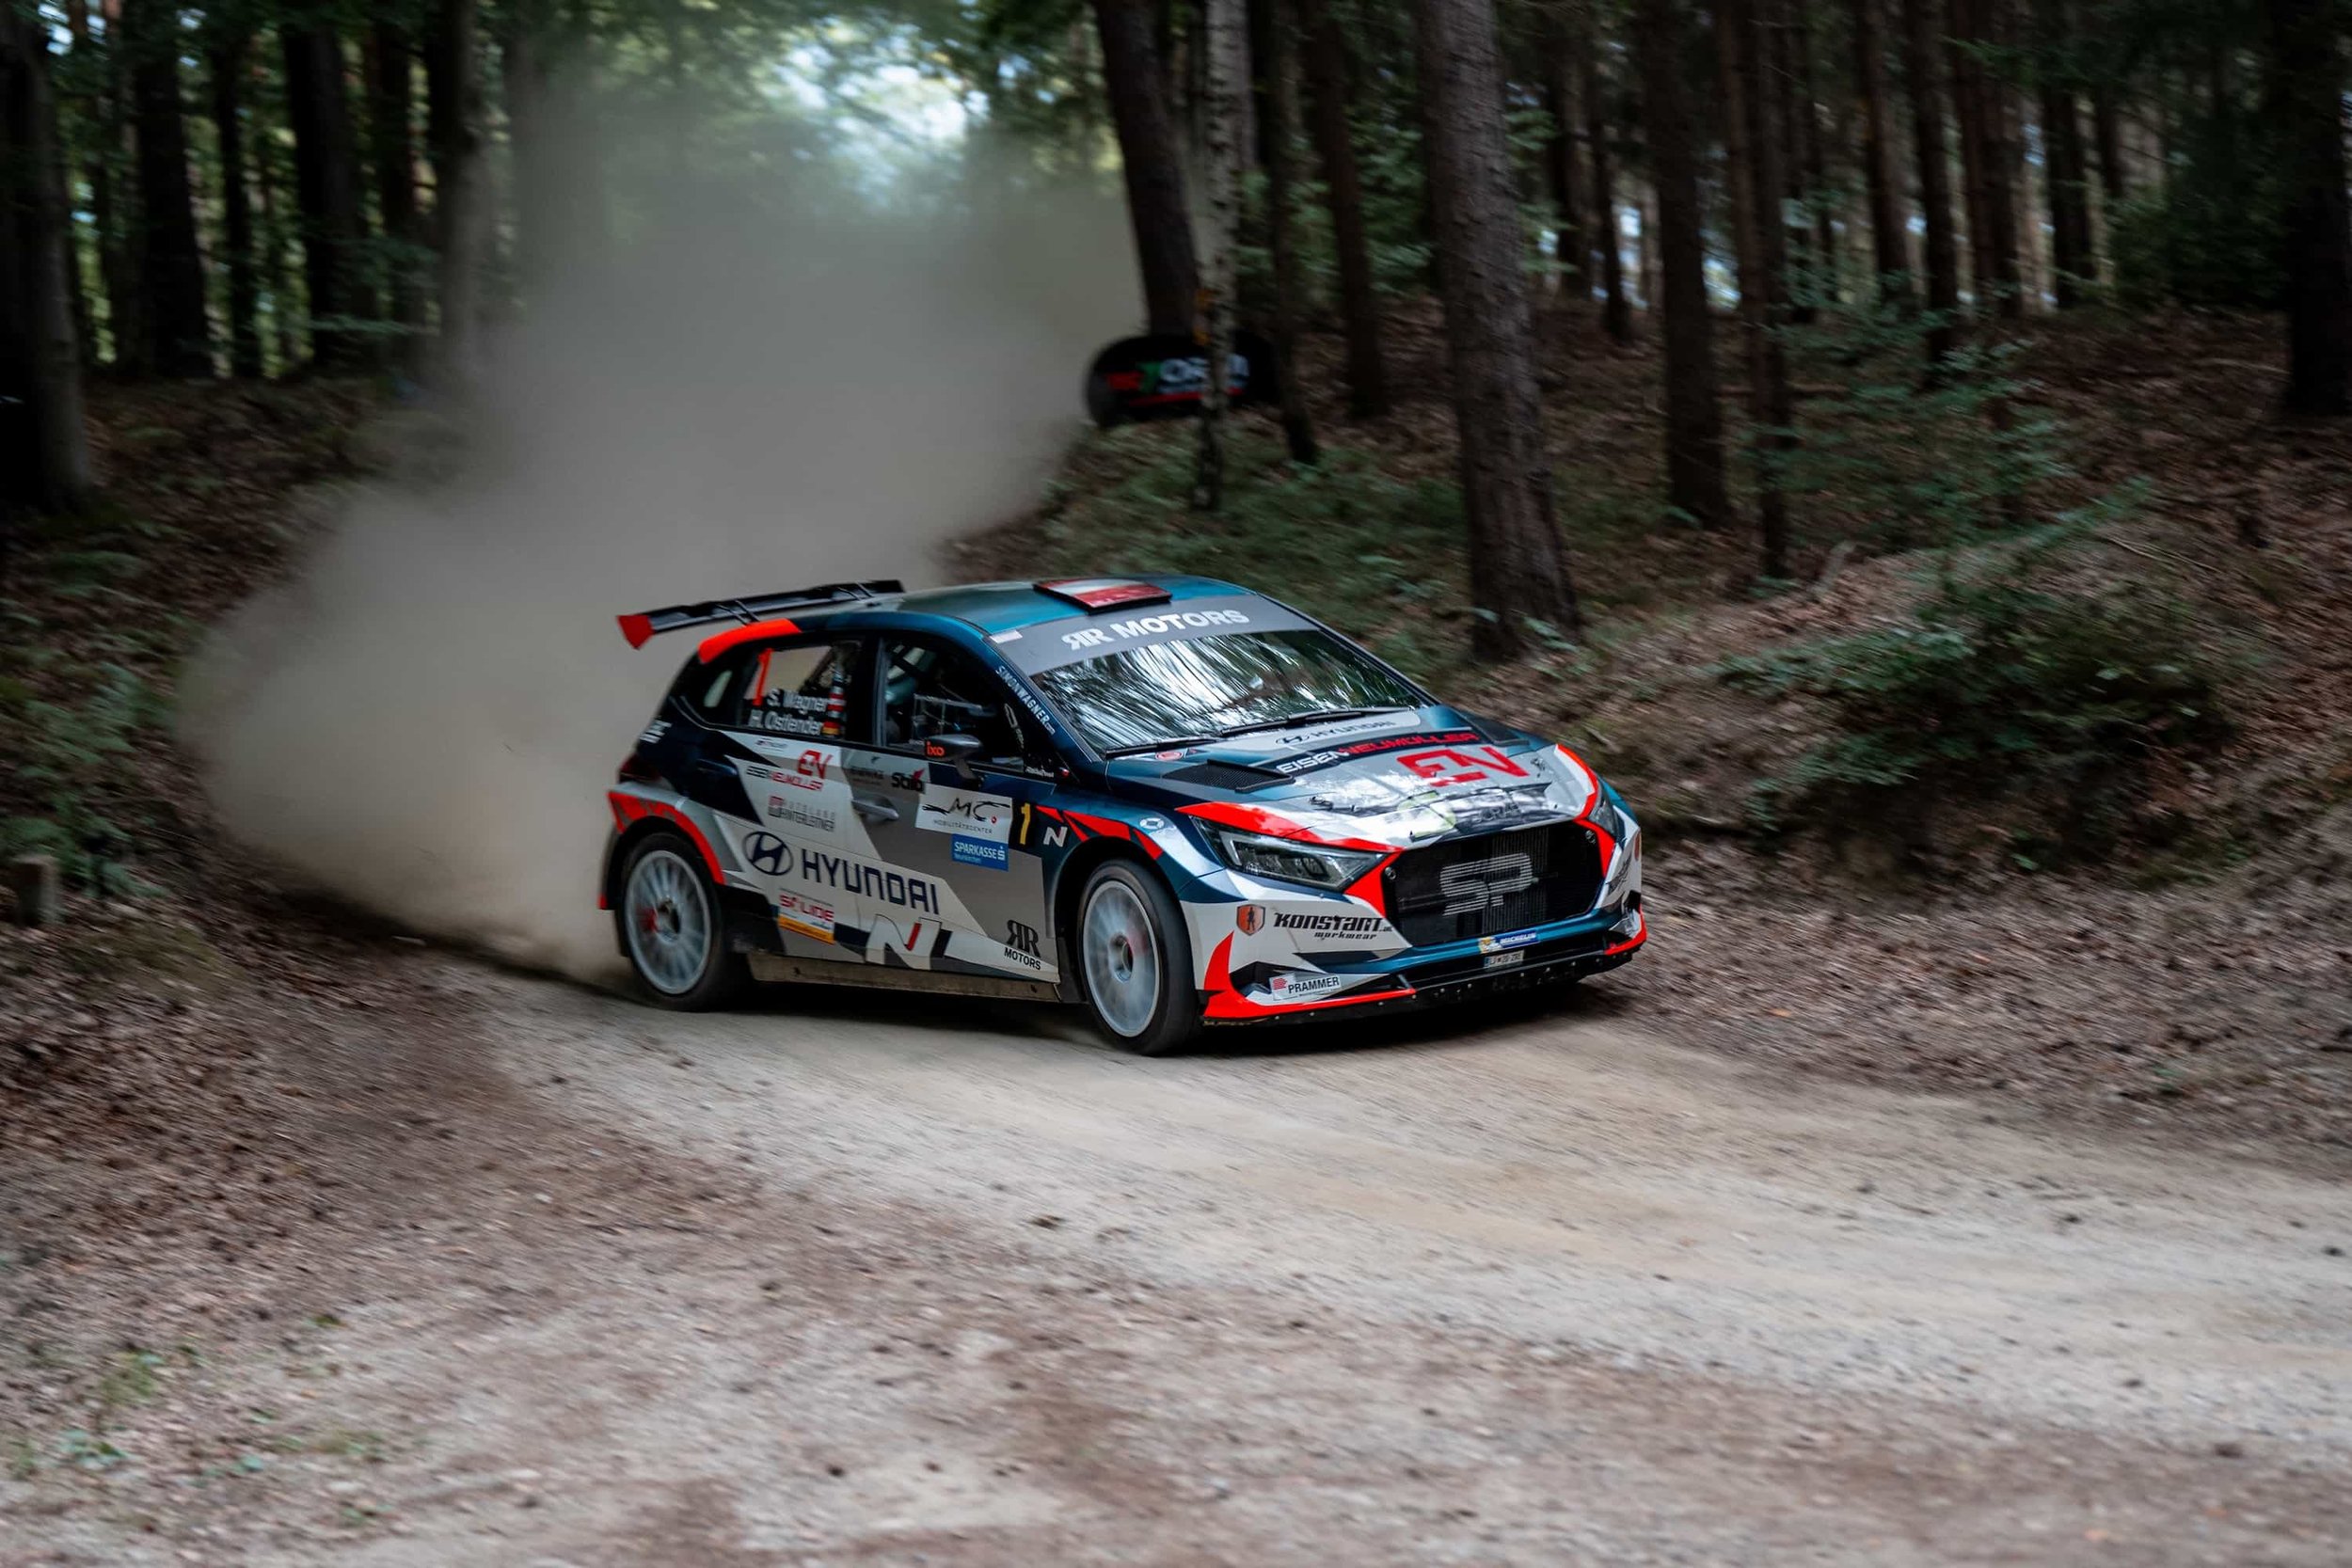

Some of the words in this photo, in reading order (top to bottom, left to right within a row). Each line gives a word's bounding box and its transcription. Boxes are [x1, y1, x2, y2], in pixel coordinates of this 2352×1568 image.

[1109, 609, 1251, 640] MOTORS
[1310, 721, 1398, 738] HYUNDAI
[926, 740, 946, 756] ixo
[1019, 802, 1032, 846] 1
[954, 841, 997, 860] SPARKASSE
[802, 848, 940, 915] HYUNDAI
[1004, 946, 1041, 971] MOTORS
[1288, 976, 1340, 994] PRAMMER
